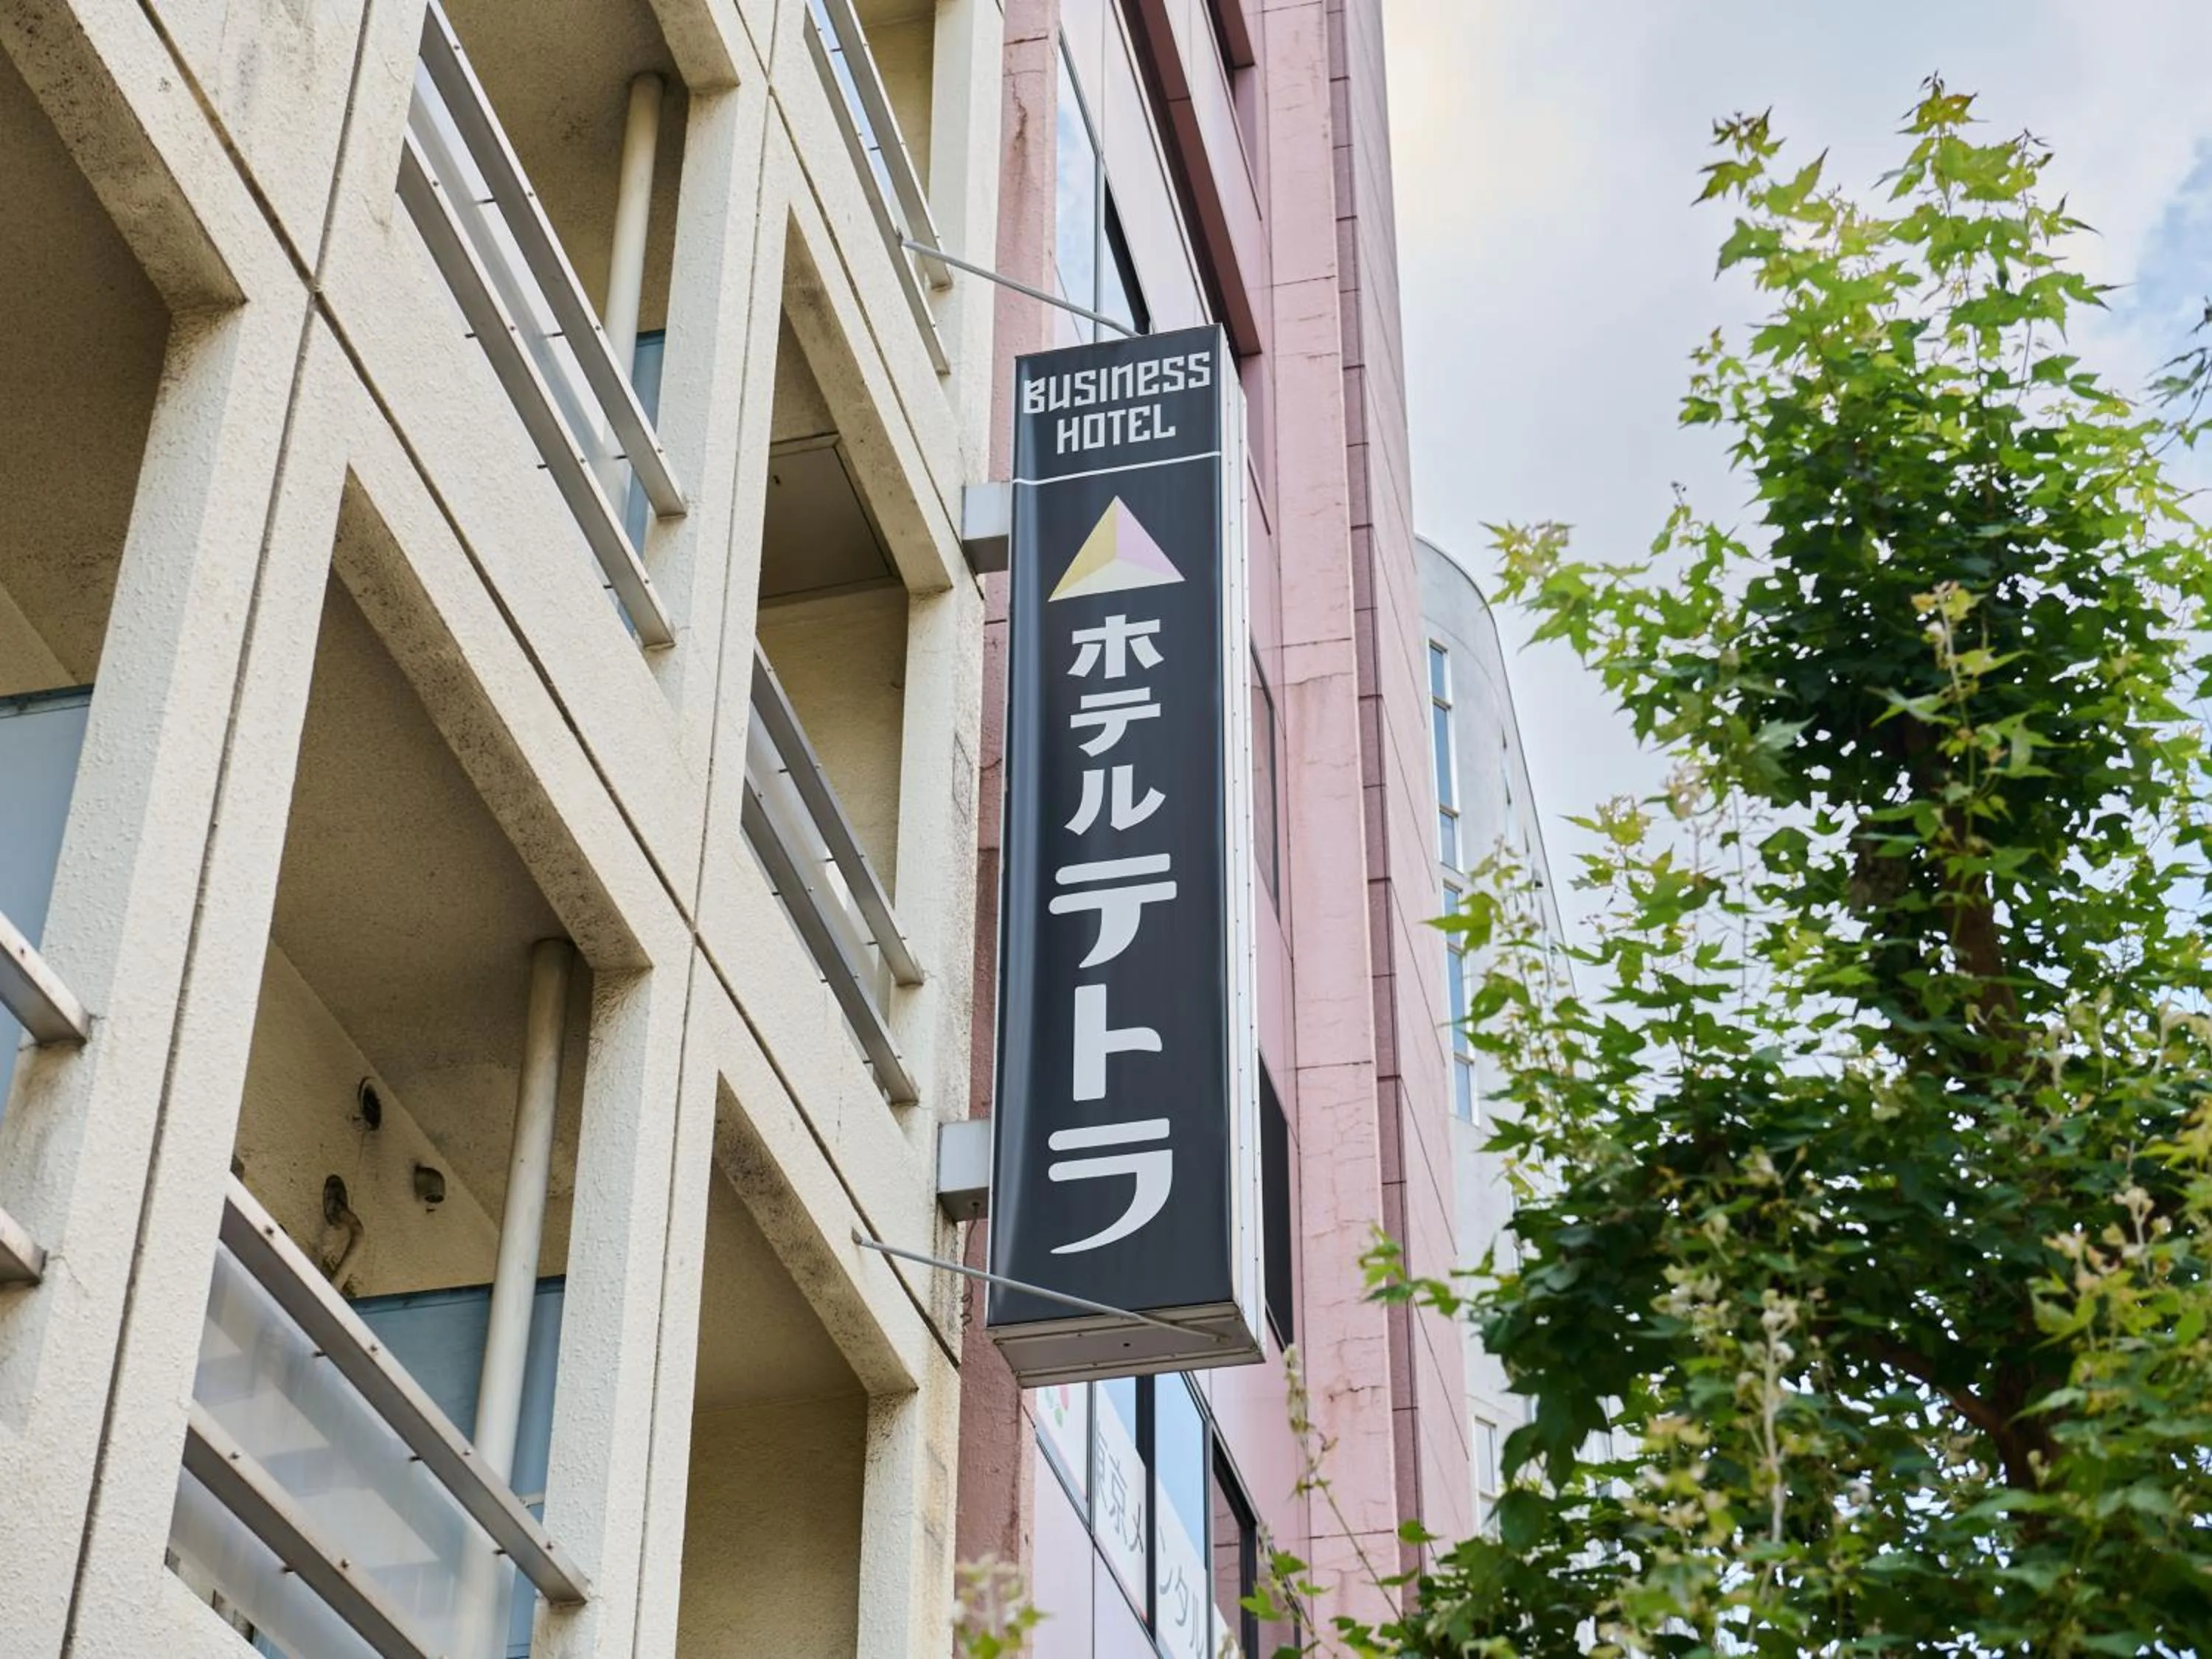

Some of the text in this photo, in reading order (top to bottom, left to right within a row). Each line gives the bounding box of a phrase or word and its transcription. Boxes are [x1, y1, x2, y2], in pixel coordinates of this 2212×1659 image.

[1057, 404, 1177, 454] HOTEL
[1048, 614, 1178, 1254] ホテルテトラ
